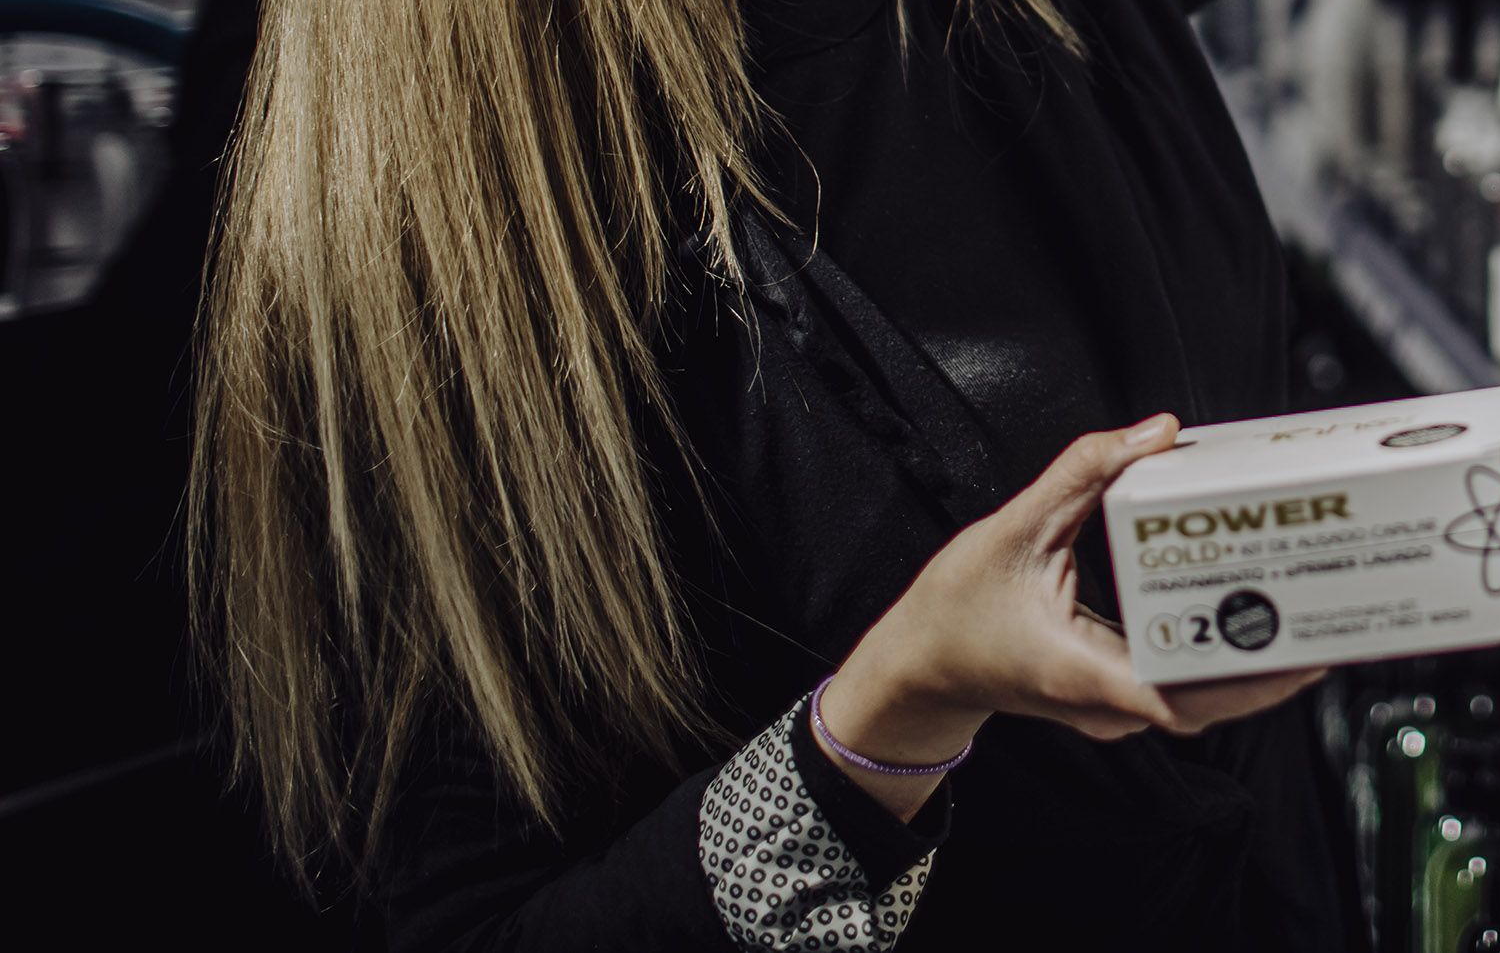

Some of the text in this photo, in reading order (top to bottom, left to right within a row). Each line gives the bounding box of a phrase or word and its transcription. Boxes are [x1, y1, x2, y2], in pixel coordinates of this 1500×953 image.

[1134, 492, 1352, 543] POWER
[1138, 541, 1221, 569] GOLD
[1158, 621, 1172, 645] 1
[1189, 614, 1214, 644] 2
